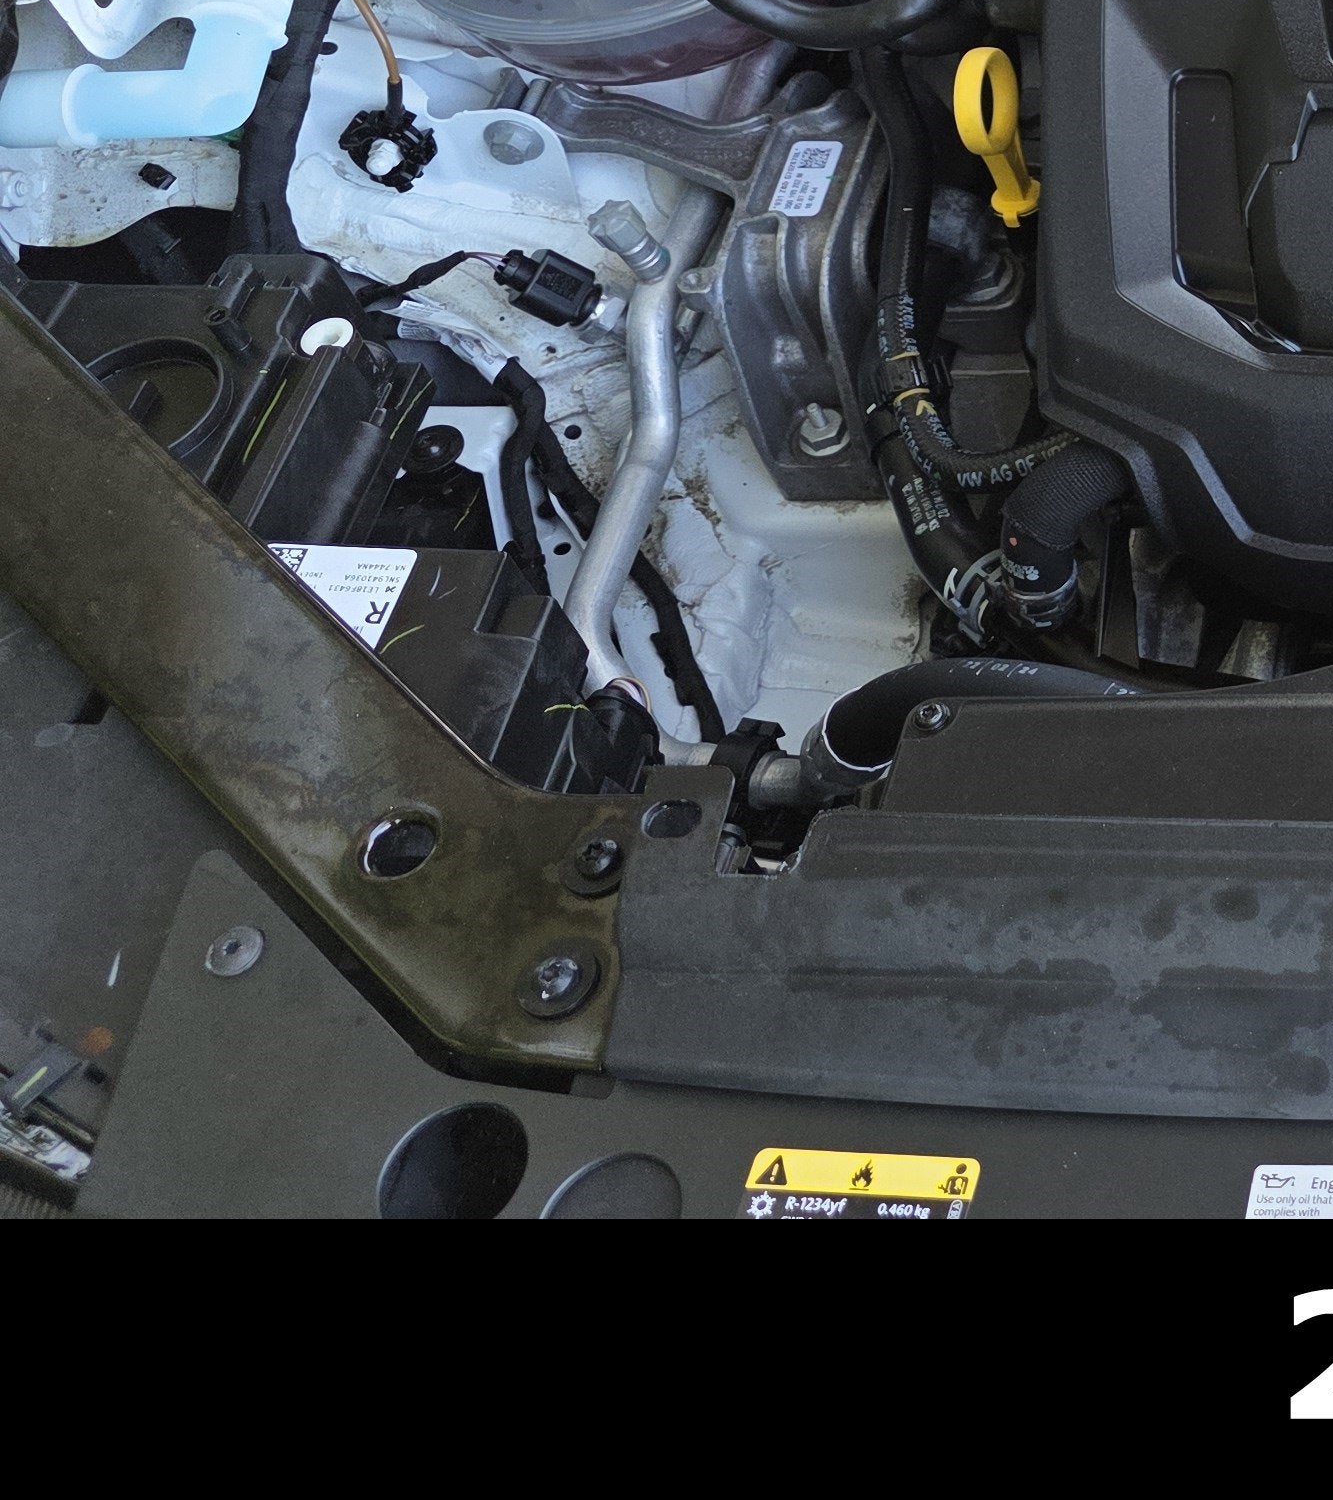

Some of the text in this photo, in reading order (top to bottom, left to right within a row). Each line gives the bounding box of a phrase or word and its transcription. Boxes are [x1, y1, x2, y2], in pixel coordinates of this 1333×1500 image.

[957, 471, 982, 488] VW
[990, 467, 1013, 485] AG
[365, 601, 389, 624] R
[784, 1196, 848, 1215] R-1234yf
[1256, 1194, 1274, 1204] Use
[1276, 1194, 1296, 1206] only
[1298, 1195, 1310, 1204] oil
[1312, 1195, 1332, 1205] that
[877, 1203, 913, 1216] 0.460
[914, 1206, 931, 1219] kg
[1253, 1207, 1320, 1218] complies with
